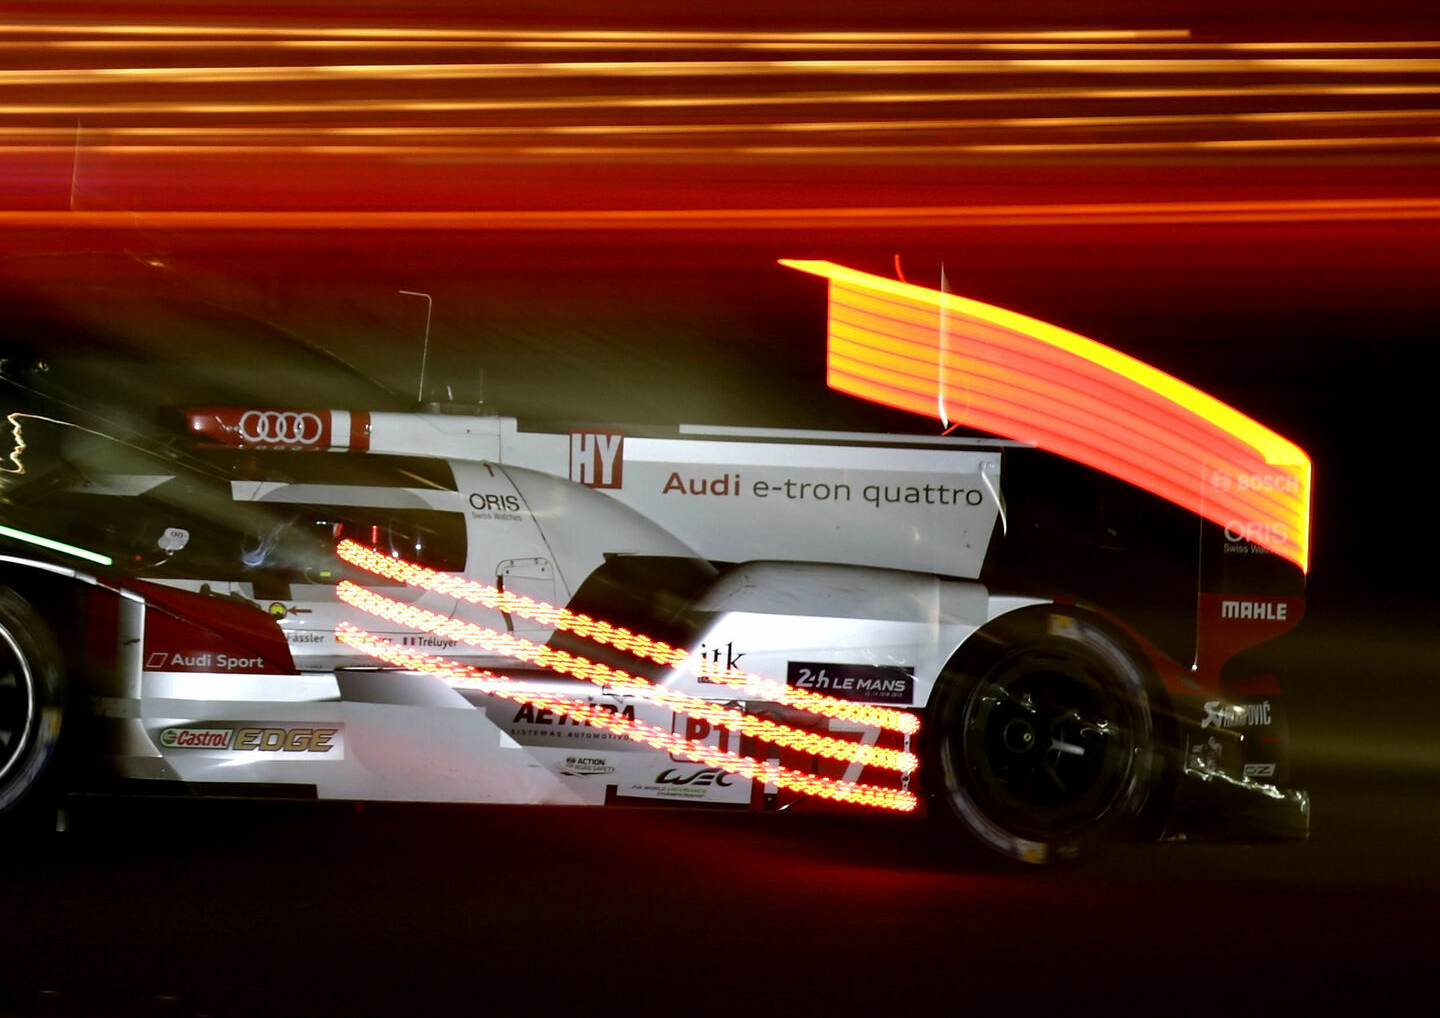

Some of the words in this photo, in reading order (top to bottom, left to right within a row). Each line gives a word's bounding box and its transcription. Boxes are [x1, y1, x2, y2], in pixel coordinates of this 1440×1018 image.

[571, 433, 622, 484] HY
[662, 472, 740, 496] Audi
[753, 479, 850, 501] e-tron
[863, 483, 983, 508] quattro
[1237, 474, 1298, 492] BOSCH
[469, 493, 520, 512] ORIS
[1224, 520, 1289, 543] ORIS
[1222, 600, 1287, 621] MAHLE
[171, 654, 211, 667] Audi
[216, 654, 264, 670] Sport
[832, 677, 855, 690] LE
[856, 678, 906, 692] MANS
[513, 701, 636, 727] AERA
[177, 730, 228, 747] Castrol
[232, 728, 339, 752] EDGE
[567, 732, 635, 742] AUTOMOTIVO
[577, 757, 605, 766] ACTION
